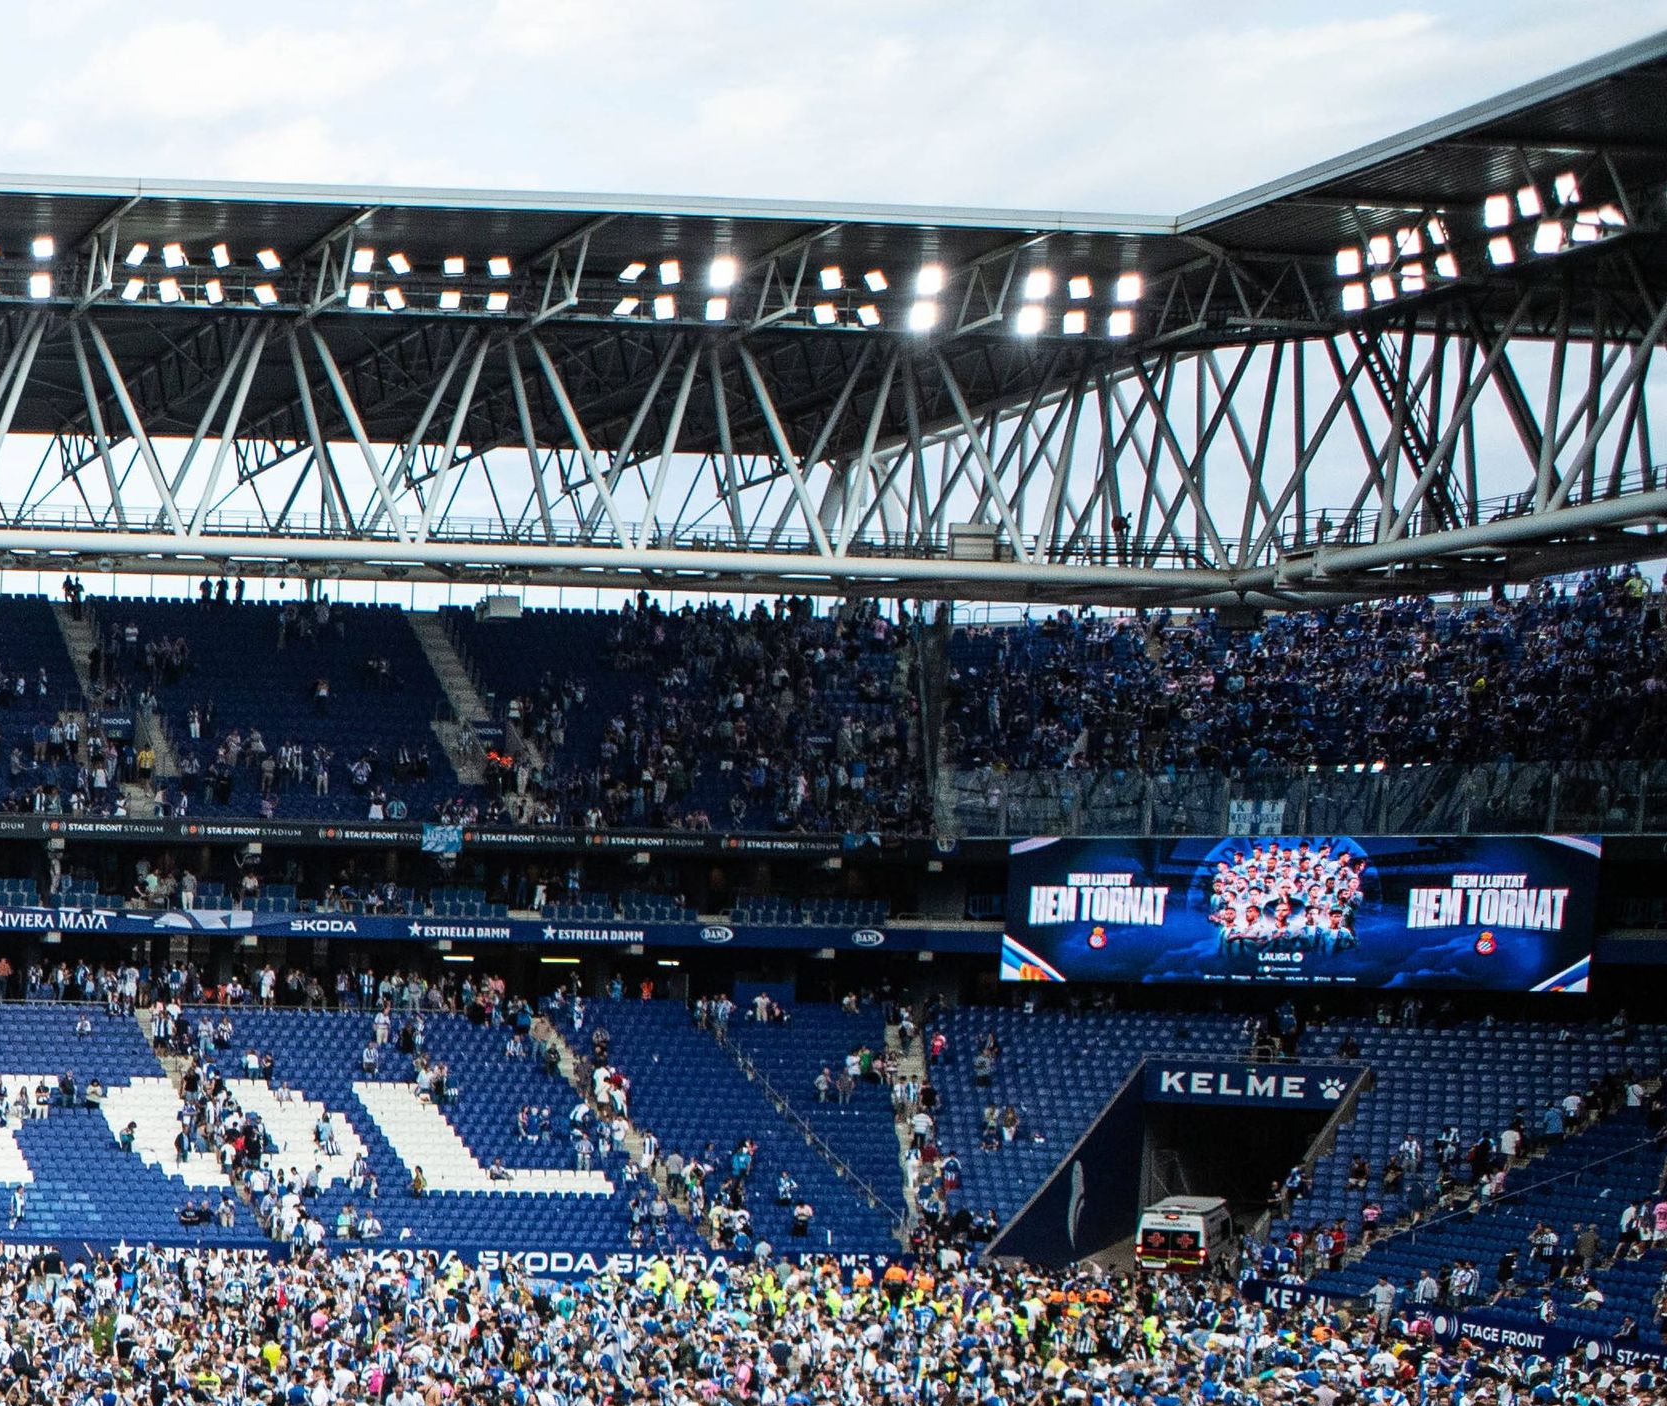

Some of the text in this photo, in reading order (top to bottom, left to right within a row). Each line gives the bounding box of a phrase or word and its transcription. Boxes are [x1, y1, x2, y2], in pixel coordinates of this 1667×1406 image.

[1452, 875, 1527, 888] HEM LLUITAT
[1029, 886, 1169, 926] HEM TORNAT
[1407, 888, 1569, 930] HEM TORNAT
[59, 909, 109, 929] MAYA
[424, 927, 510, 938] ESTRELLA DAMM
[556, 930, 643, 941] ESTRELLA DAMM
[704, 929, 728, 940] DANI
[1161, 1071, 1306, 1098] KELME
[1460, 1323, 1543, 1349] STAGE FRONT
